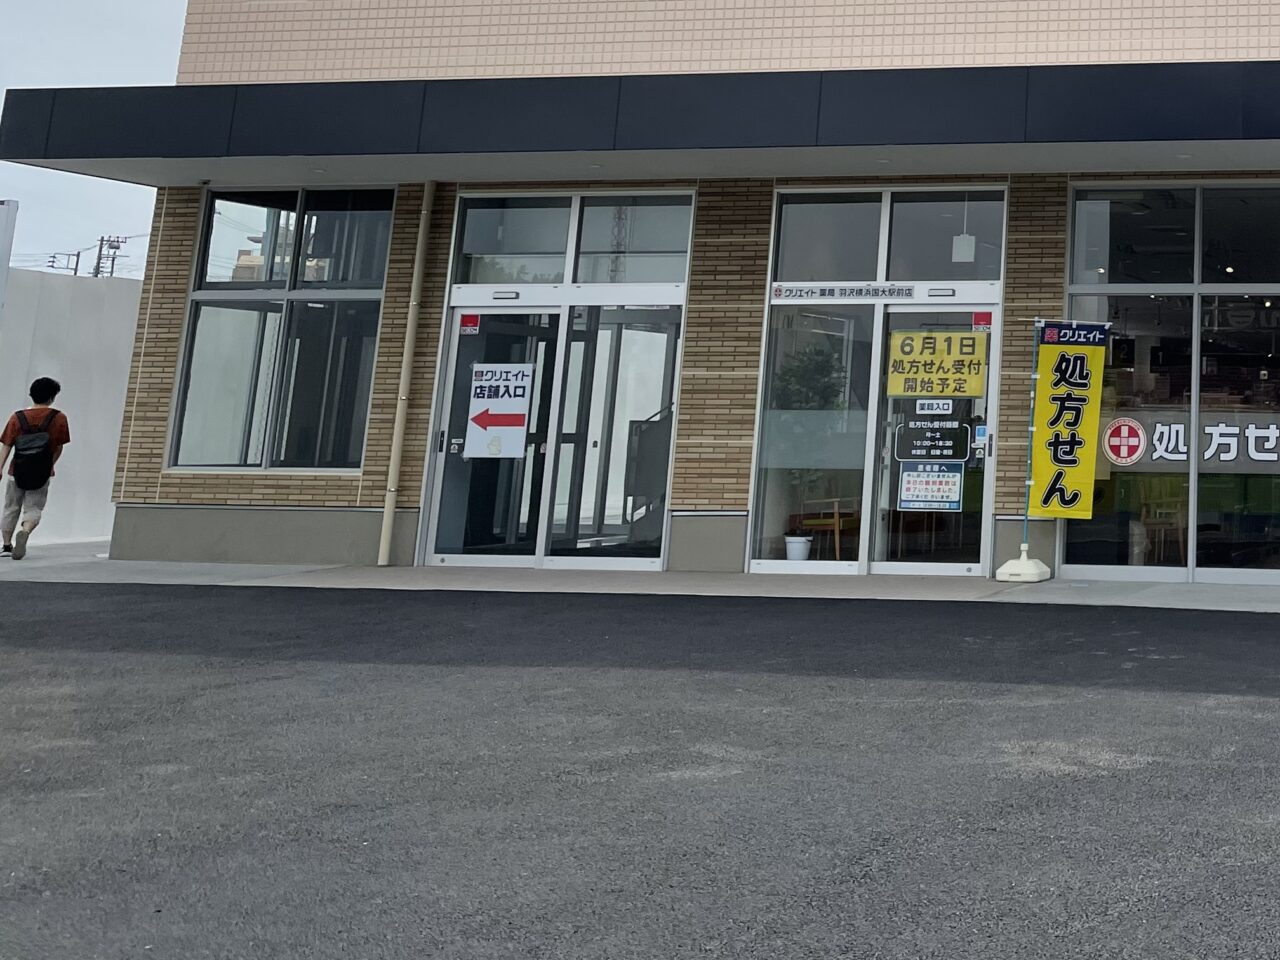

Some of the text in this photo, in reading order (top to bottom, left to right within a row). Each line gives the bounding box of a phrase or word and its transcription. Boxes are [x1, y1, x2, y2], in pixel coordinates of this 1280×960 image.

[784, 288, 817, 298] クリエイト
[1059, 329, 1105, 342] クリエイト
[899, 336, 977, 356] 6月1日
[891, 359, 982, 375] 処方せん受付
[473, 385, 526, 399] 店舗入口
[902, 377, 968, 393] 開始予定
[1041, 352, 1091, 508] 処方せん
